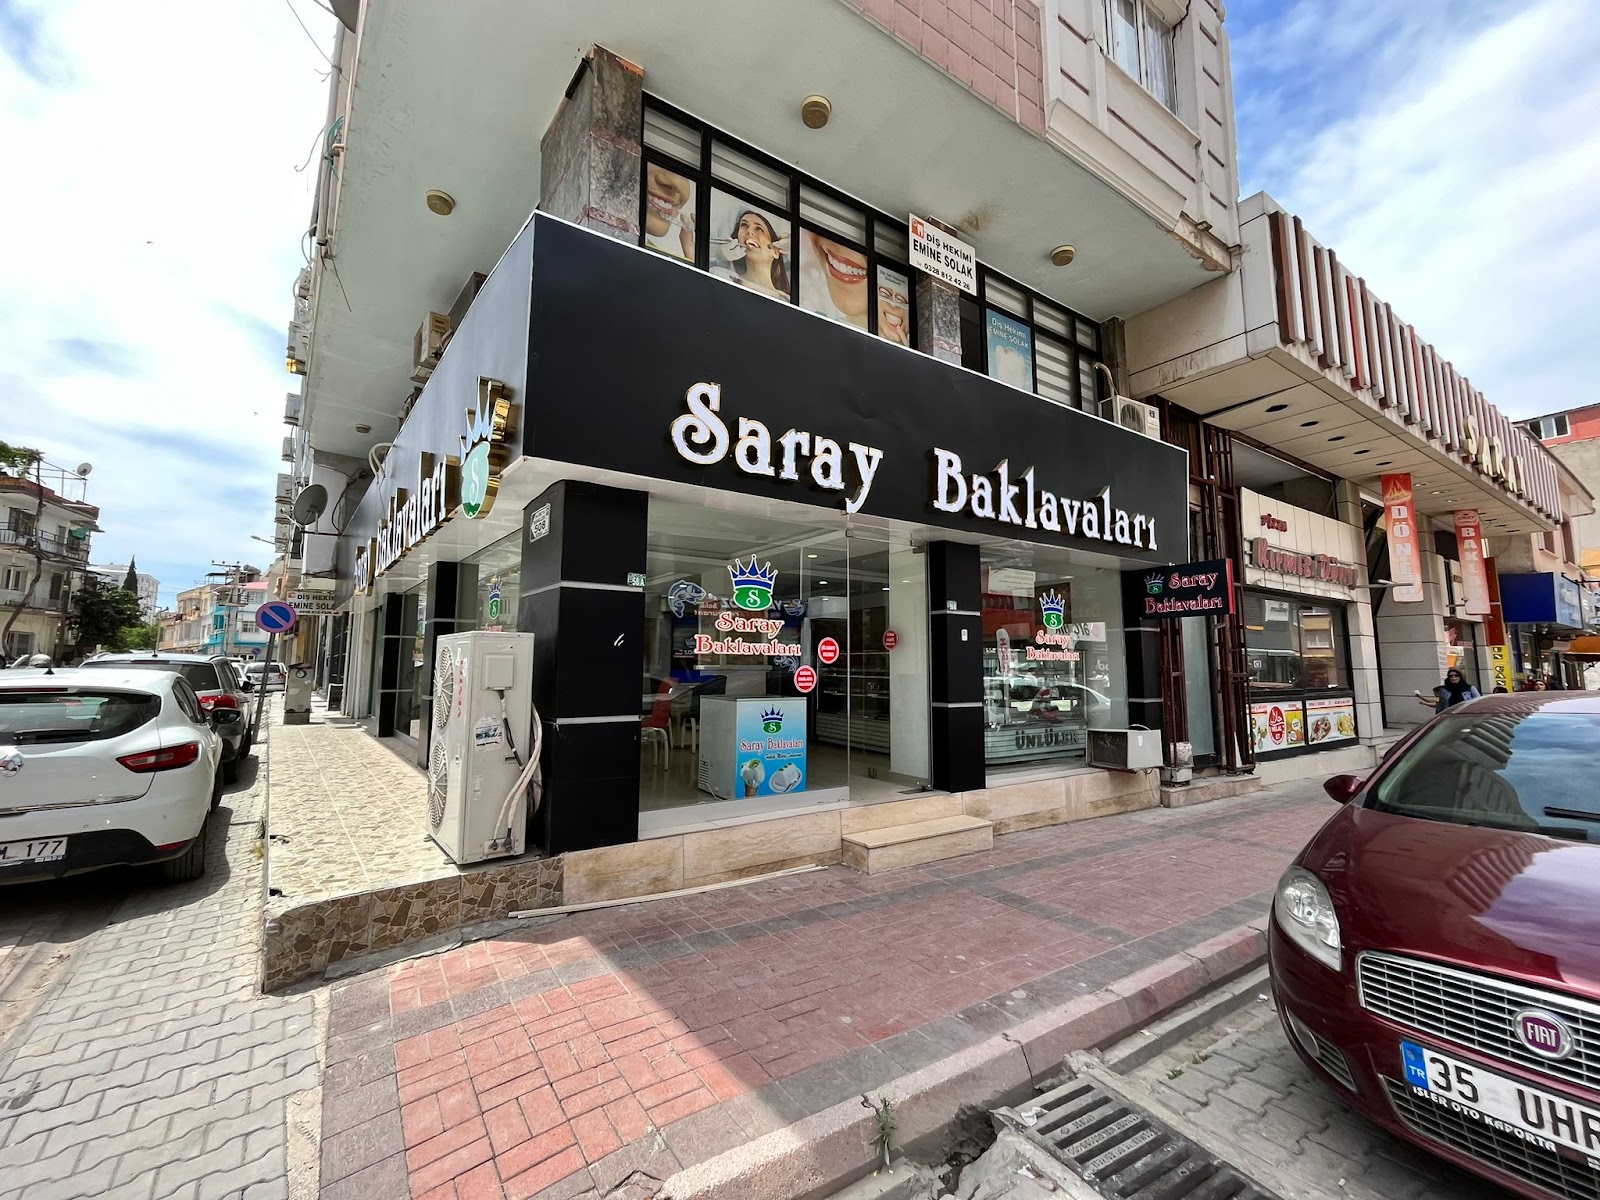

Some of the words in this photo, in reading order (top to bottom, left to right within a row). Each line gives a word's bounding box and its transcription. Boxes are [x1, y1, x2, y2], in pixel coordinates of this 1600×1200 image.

[913, 238, 942, 264] EMİNE
[944, 254, 973, 279] SOLAK
[926, 233, 941, 248] DİŞ
[943, 242, 972, 263] HEKİMİ
[1009, 334, 1029, 349] SOLAK
[670, 381, 884, 515] Saray
[933, 447, 1158, 552] Baklavaları
[1168, 572, 1219, 591] Saray
[315, 602, 336, 610] SOLA
[1145, 594, 1223, 614] Baklavaları
[715, 611, 785, 639] Saray
[694, 634, 801, 656] Baklavaları
[1035, 630, 1071, 649] Saray
[740, 738, 764, 755] Saray
[27, 840, 63, 857] 177
[1526, 1021, 1558, 1048] FIAT
[1408, 1065, 1426, 1080] TR
[1429, 1056, 1479, 1104] 35
[1451, 1101, 1480, 1120] OTO
[1484, 1115, 1557, 1153] KAPORTA
